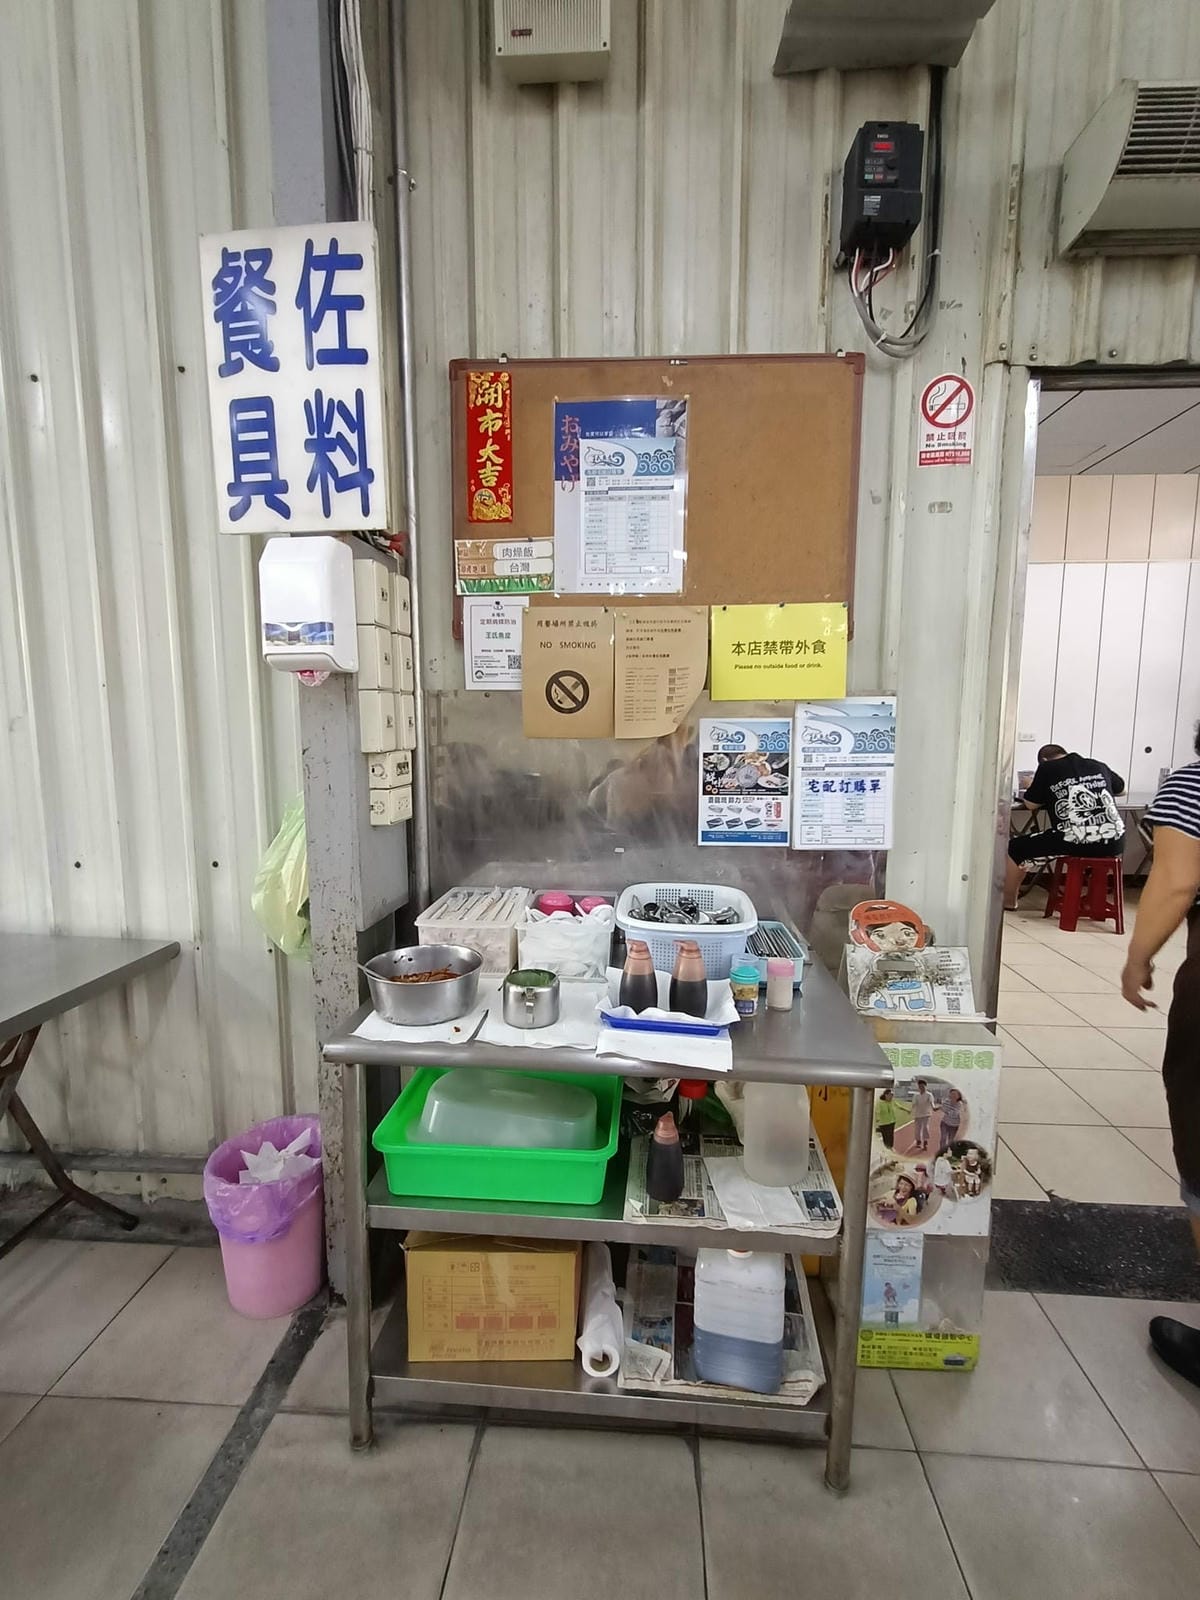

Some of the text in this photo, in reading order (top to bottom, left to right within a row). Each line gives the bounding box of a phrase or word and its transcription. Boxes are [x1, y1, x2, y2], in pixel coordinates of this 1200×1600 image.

[212, 246, 291, 522] 餐具
[295, 237, 375, 519] 佐料
[476, 381, 504, 487] 開市大吉
[510, 562, 530, 573] 台灣
[540, 641, 597, 649] NO SMOKING
[731, 639, 827, 657] 本店禁帶外食
[807, 778, 882, 794] 宅配訂購單
